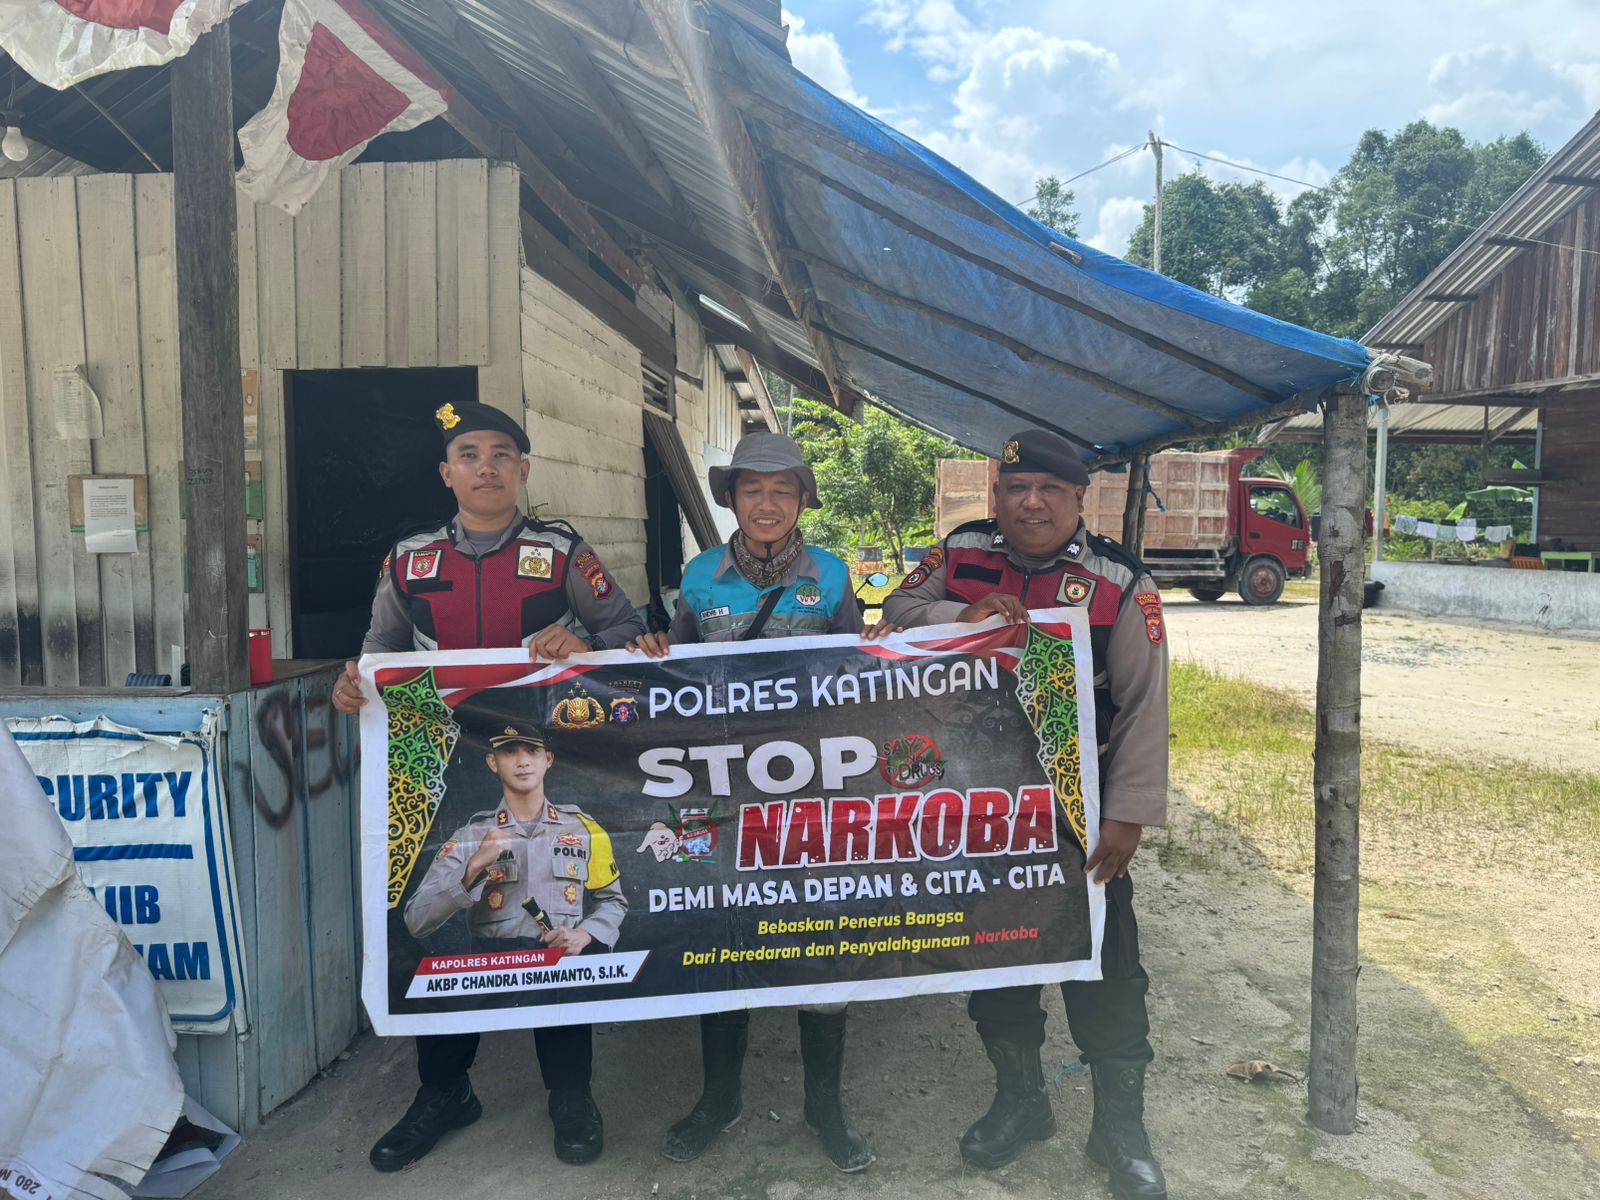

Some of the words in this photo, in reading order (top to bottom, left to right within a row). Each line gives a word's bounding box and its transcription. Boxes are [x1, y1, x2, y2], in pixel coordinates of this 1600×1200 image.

[649, 677, 798, 719] POLRES
[811, 656, 999, 708] KATINGAN
[637, 735, 878, 797] STOP
[735, 784, 1059, 871] NARKOBA
[553, 846, 587, 860] POLRI
[649, 886, 714, 913] DEMI
[723, 881, 798, 907] MASA
[803, 874, 893, 903] DEPAN
[900, 873, 919, 897] &
[926, 869, 986, 895] CITA
[1007, 863, 1066, 890] CITA
[758, 917, 835, 936] Bebaskan
[838, 914, 901, 931] Penerus
[905, 911, 964, 930] Bangsa
[431, 957, 488, 970] KAPOLRES
[490, 953, 545, 966] KATINGAN
[682, 948, 716, 966] Dari
[719, 944, 801, 964] Peredaran
[805, 941, 835, 957] dan
[839, 935, 970, 958] Penyalahgunaan
[973, 926, 1039, 945] Narkoba
[426, 977, 459, 992] AKBP
[461, 973, 518, 990] CHANDRA
[521, 968, 596, 987] ISMAWANTO,
[598, 965, 628, 980] S.I.K.
